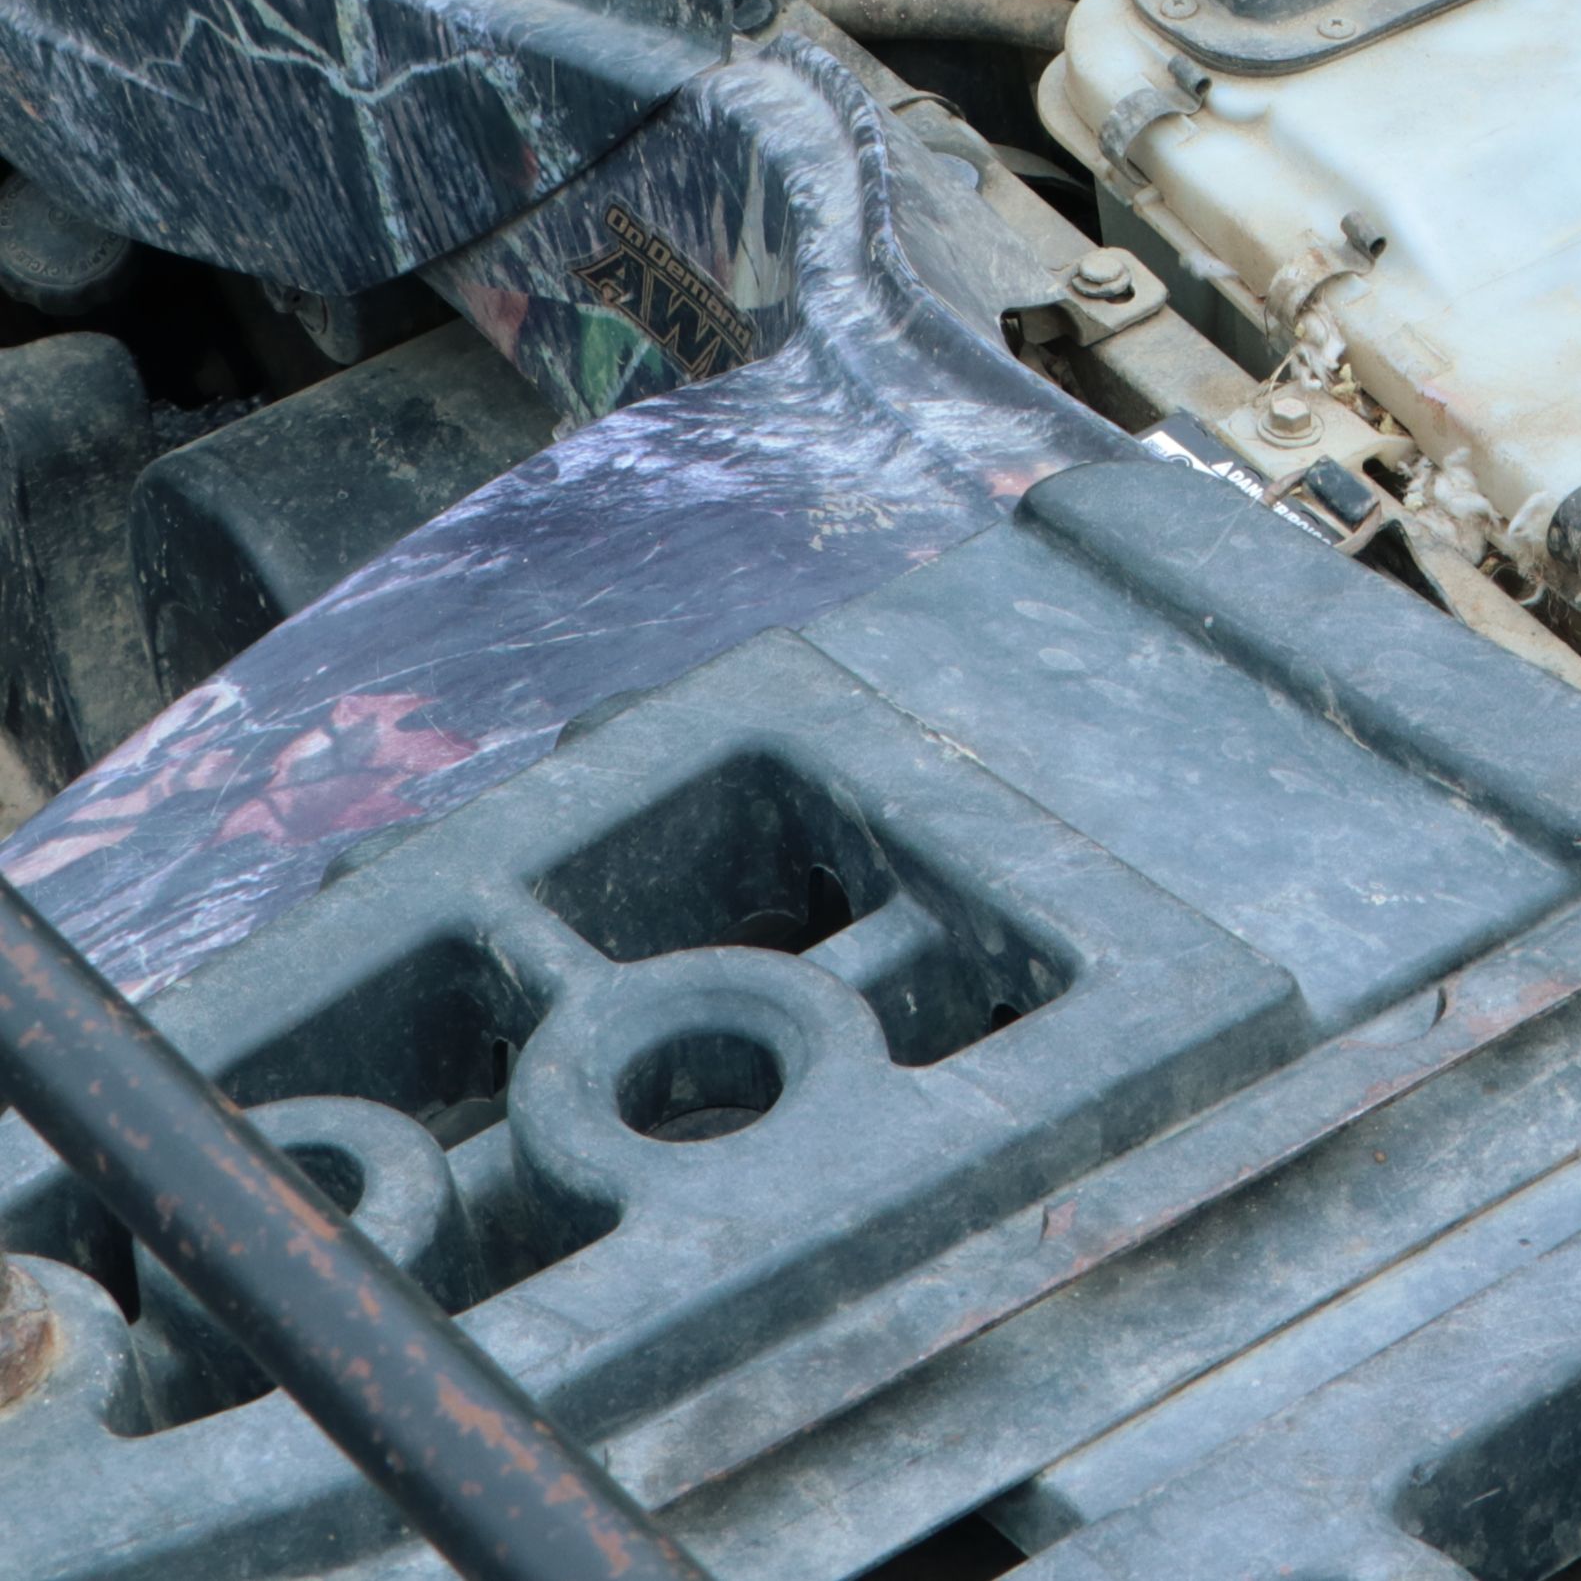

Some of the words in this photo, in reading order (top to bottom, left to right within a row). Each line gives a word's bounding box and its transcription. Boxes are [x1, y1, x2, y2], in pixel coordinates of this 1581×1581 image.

[16, 251, 61, 277] CYCLE
[606, 205, 645, 249] On
[648, 238, 752, 350] Demand
